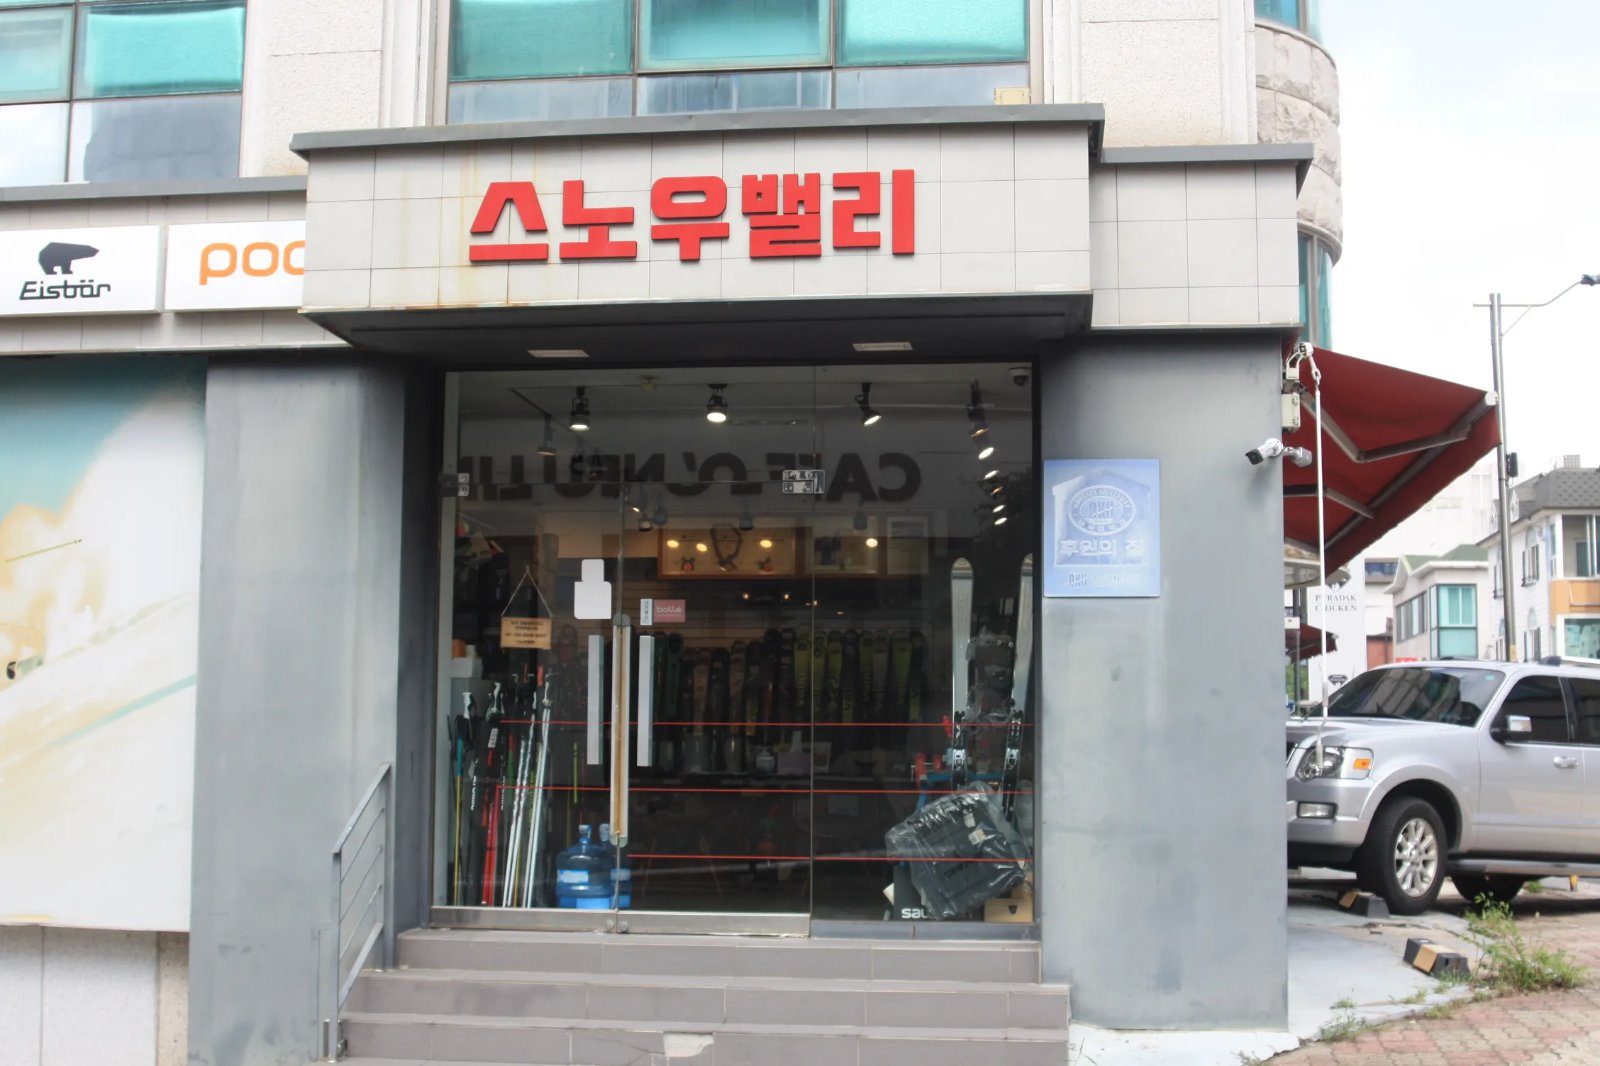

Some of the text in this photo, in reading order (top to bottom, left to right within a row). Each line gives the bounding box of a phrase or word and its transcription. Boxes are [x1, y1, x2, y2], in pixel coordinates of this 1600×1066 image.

[469, 169, 915, 262] 스노우밸리
[19, 279, 111, 301] Eisbär
[1060, 539, 1117, 558] 후원의
[1315, 594, 1357, 602] PRADAK
